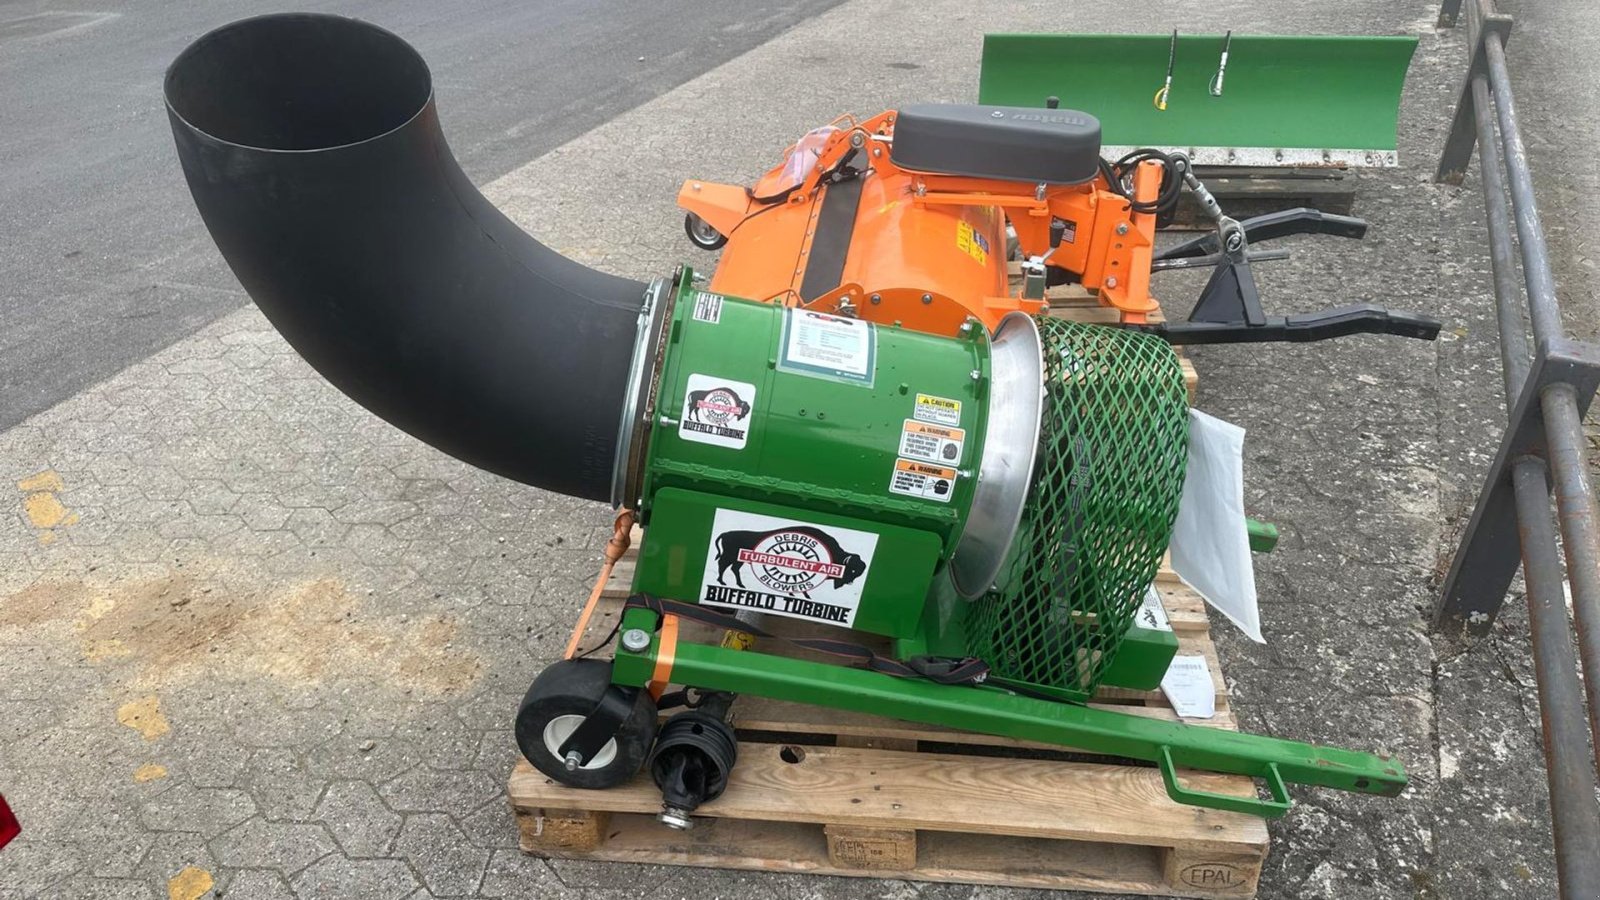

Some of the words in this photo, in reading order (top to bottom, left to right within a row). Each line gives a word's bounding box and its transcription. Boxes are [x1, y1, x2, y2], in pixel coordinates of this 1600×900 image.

[931, 399, 955, 409] CAUTION
[683, 420, 714, 435] BUFFALO
[715, 426, 745, 440] TURBINE
[926, 427, 951, 437] WARNING
[906, 437, 924, 445] REQUIRED
[916, 434, 939, 442] PROTECTION
[918, 465, 943, 475] WARNING
[774, 533, 819, 549] DEBRIS
[742, 551, 819, 571] TURBULENT
[819, 563, 841, 576] AIR
[759, 574, 815, 593] BLOWERS
[704, 585, 777, 610] BUFFALO
[783, 596, 852, 624] TURBINE
